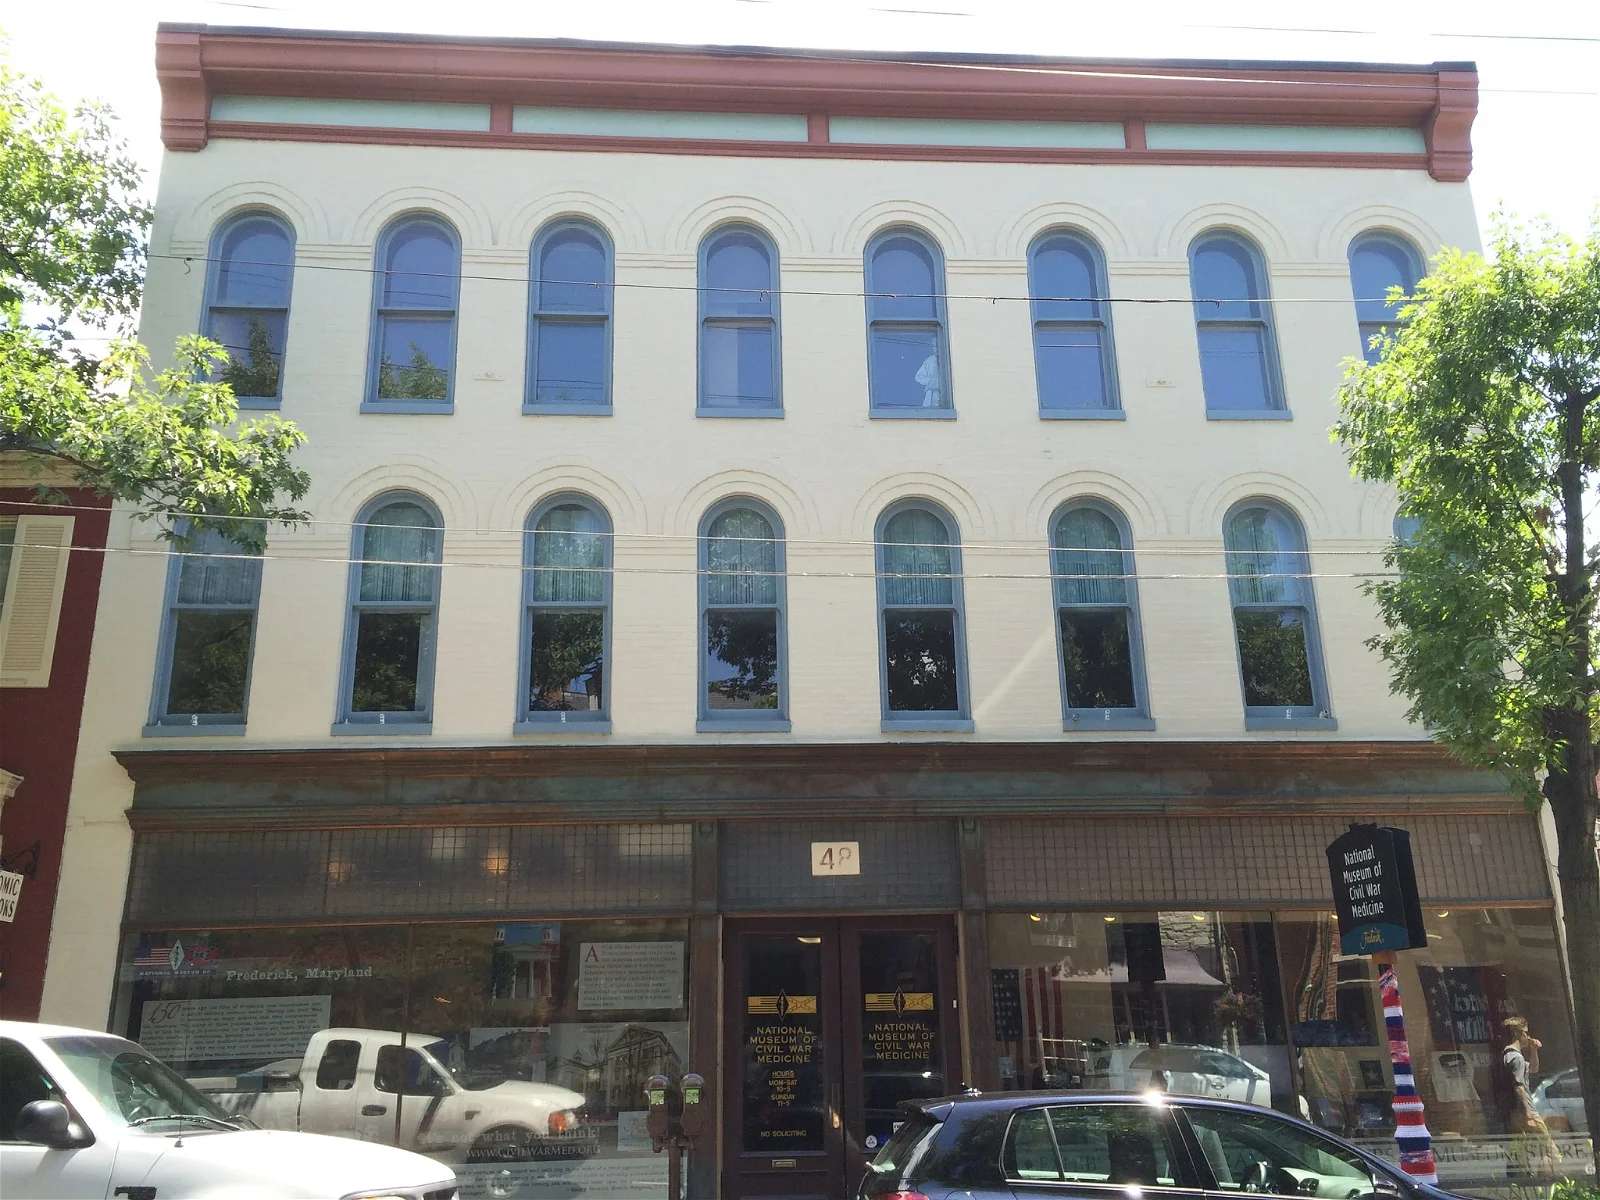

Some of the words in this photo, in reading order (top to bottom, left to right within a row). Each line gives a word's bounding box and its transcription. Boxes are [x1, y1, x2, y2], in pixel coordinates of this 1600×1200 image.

[1344, 844, 1375, 865] National
[1343, 867, 1372, 883] Museum
[1374, 861, 1383, 877] of
[1349, 884, 1366, 900] Civil
[1366, 883, 1382, 898] War
[1351, 900, 1385, 919] Medicine
[226, 970, 298, 982] Frederick,
[304, 966, 373, 981] Maryland
[148, 1001, 183, 1024] 150
[756, 1026, 812, 1034] NATIONAL
[874, 1023, 929, 1031] NATIONAL
[749, 1036, 797, 1044] MUSEUM
[868, 1033, 915, 1041] MUSEUM
[921, 1032, 936, 1040] OF
[755, 1045, 784, 1053] CIVIL
[789, 1045, 812, 1053] WAR
[874, 1042, 902, 1050] CIVIL
[907, 1042, 930, 1050] WAR
[757, 1055, 811, 1063] MEDICINE
[876, 1051, 930, 1060] MEDICINE
[772, 1070, 795, 1078] HOURS
[483, 1130, 517, 1142] what
[525, 1132, 550, 1144] you
[557, 1127, 601, 1140] think!
